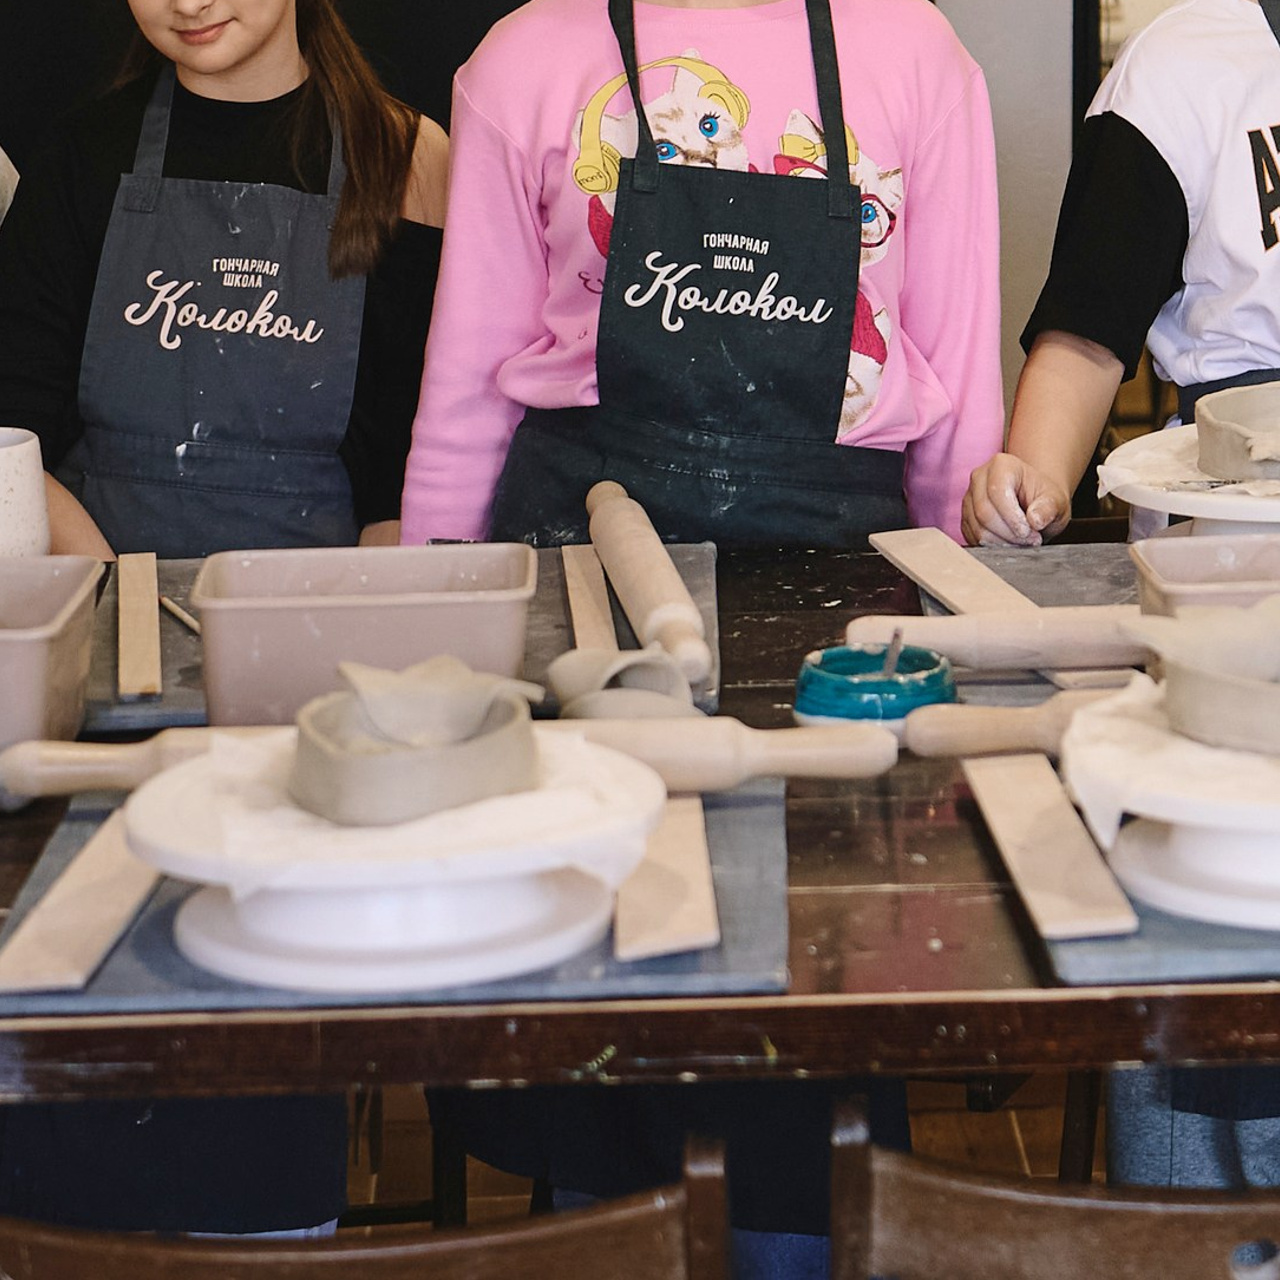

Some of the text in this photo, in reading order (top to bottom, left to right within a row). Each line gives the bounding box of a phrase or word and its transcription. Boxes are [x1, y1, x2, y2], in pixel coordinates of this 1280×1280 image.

[704, 233, 770, 256] ГОНЧАРНАЯ
[212, 258, 280, 277] ГОНЧАРНАЯ
[713, 254, 755, 273] ШКОЛА
[222, 272, 263, 289] ШКОЛА
[624, 250, 833, 333] Колокол
[124, 269, 324, 350] Колокол
